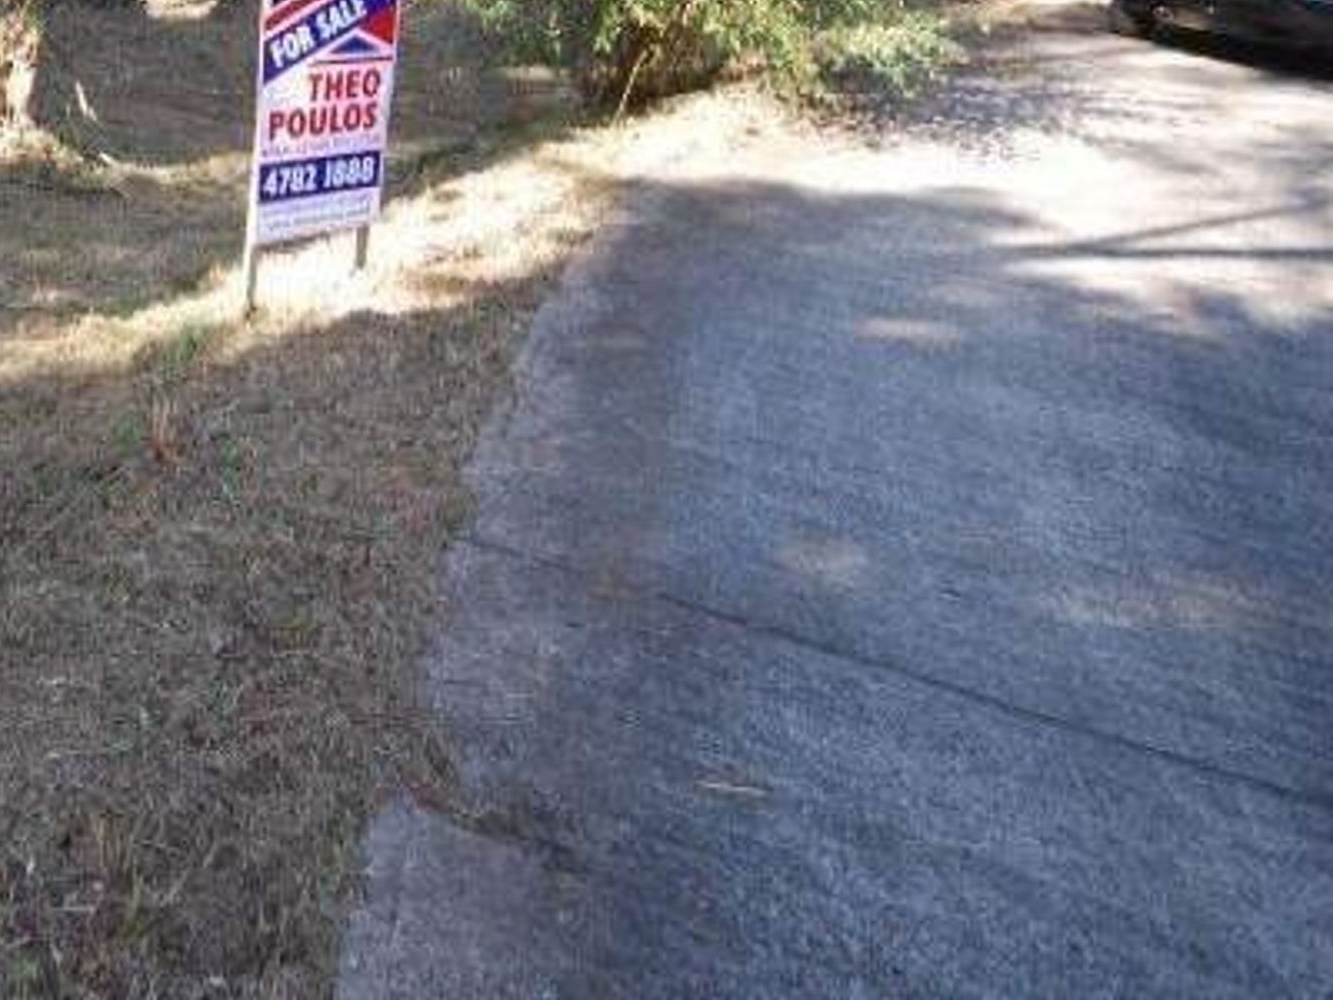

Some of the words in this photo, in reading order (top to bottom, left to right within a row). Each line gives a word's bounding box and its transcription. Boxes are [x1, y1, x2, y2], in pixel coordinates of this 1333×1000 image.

[270, 25, 314, 68] FOR
[309, 68, 381, 101] THEO
[269, 103, 377, 142] POULOS
